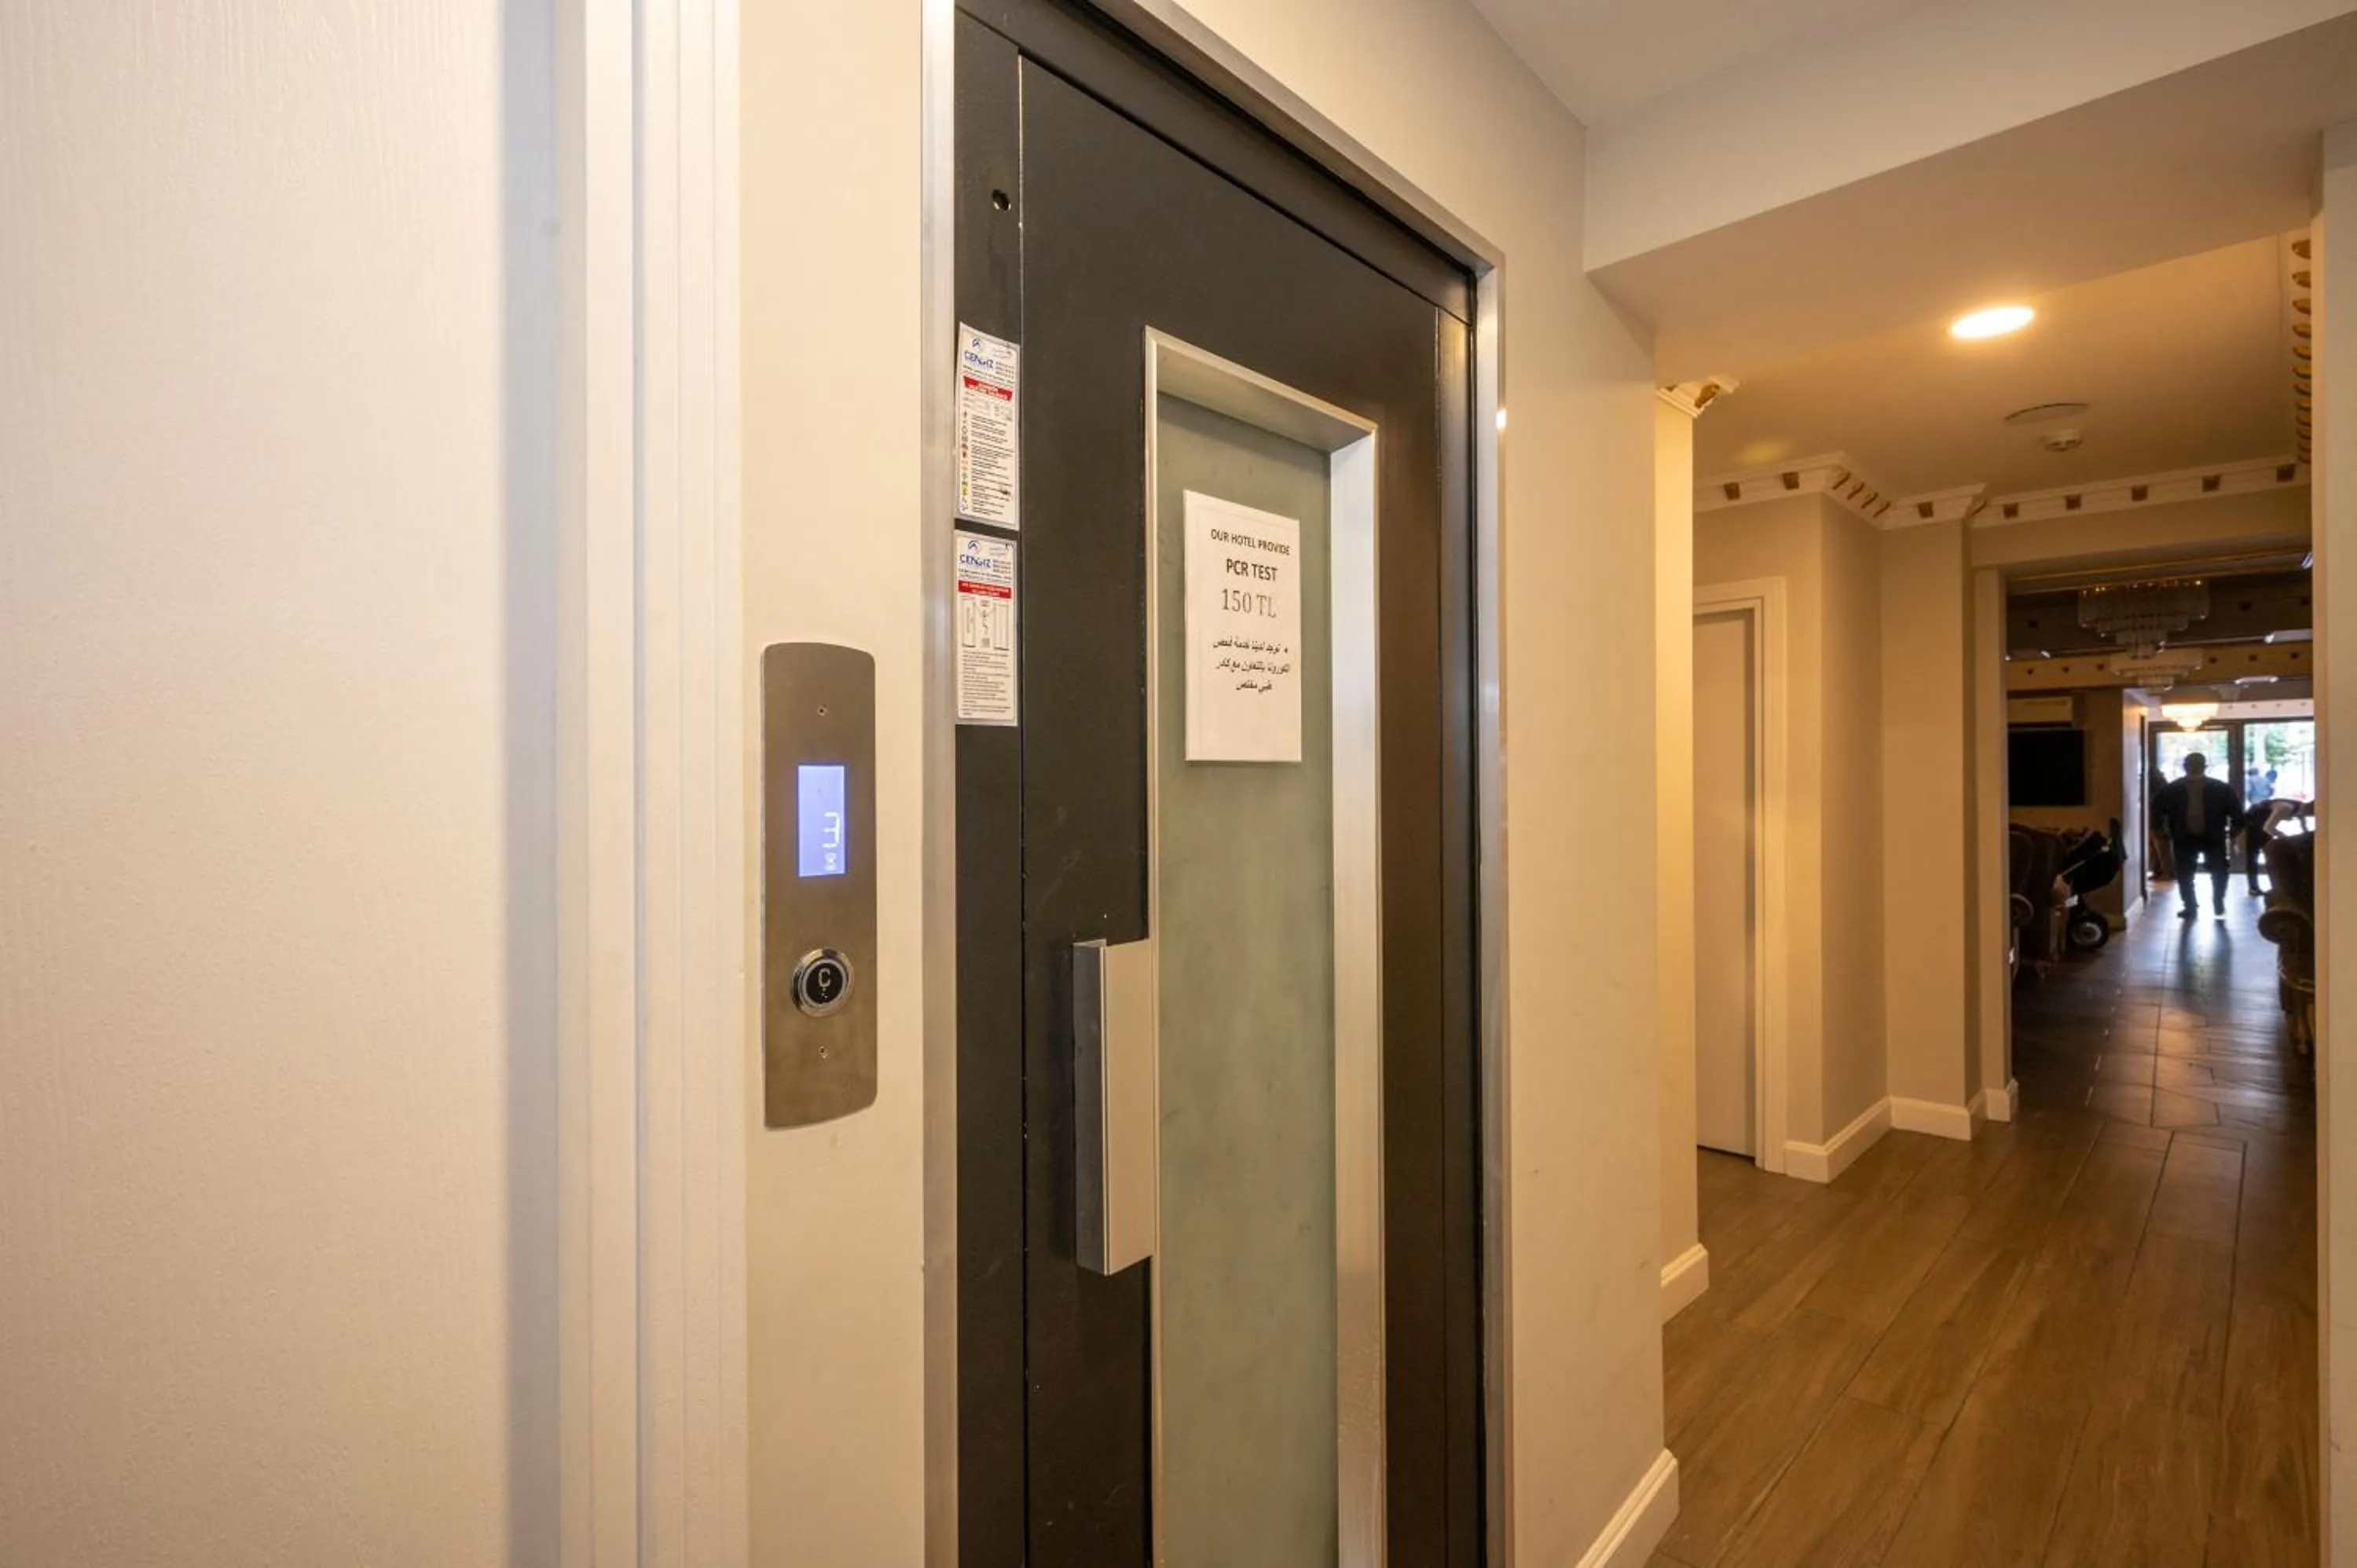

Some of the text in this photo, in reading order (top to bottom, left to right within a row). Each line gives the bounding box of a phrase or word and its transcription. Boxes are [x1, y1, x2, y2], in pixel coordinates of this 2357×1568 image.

[1211, 529, 1291, 556] OUR HOTEL PROVIDE
[1226, 559, 1278, 581] PCR TEST
[1222, 588, 1277, 619] 150 TL
